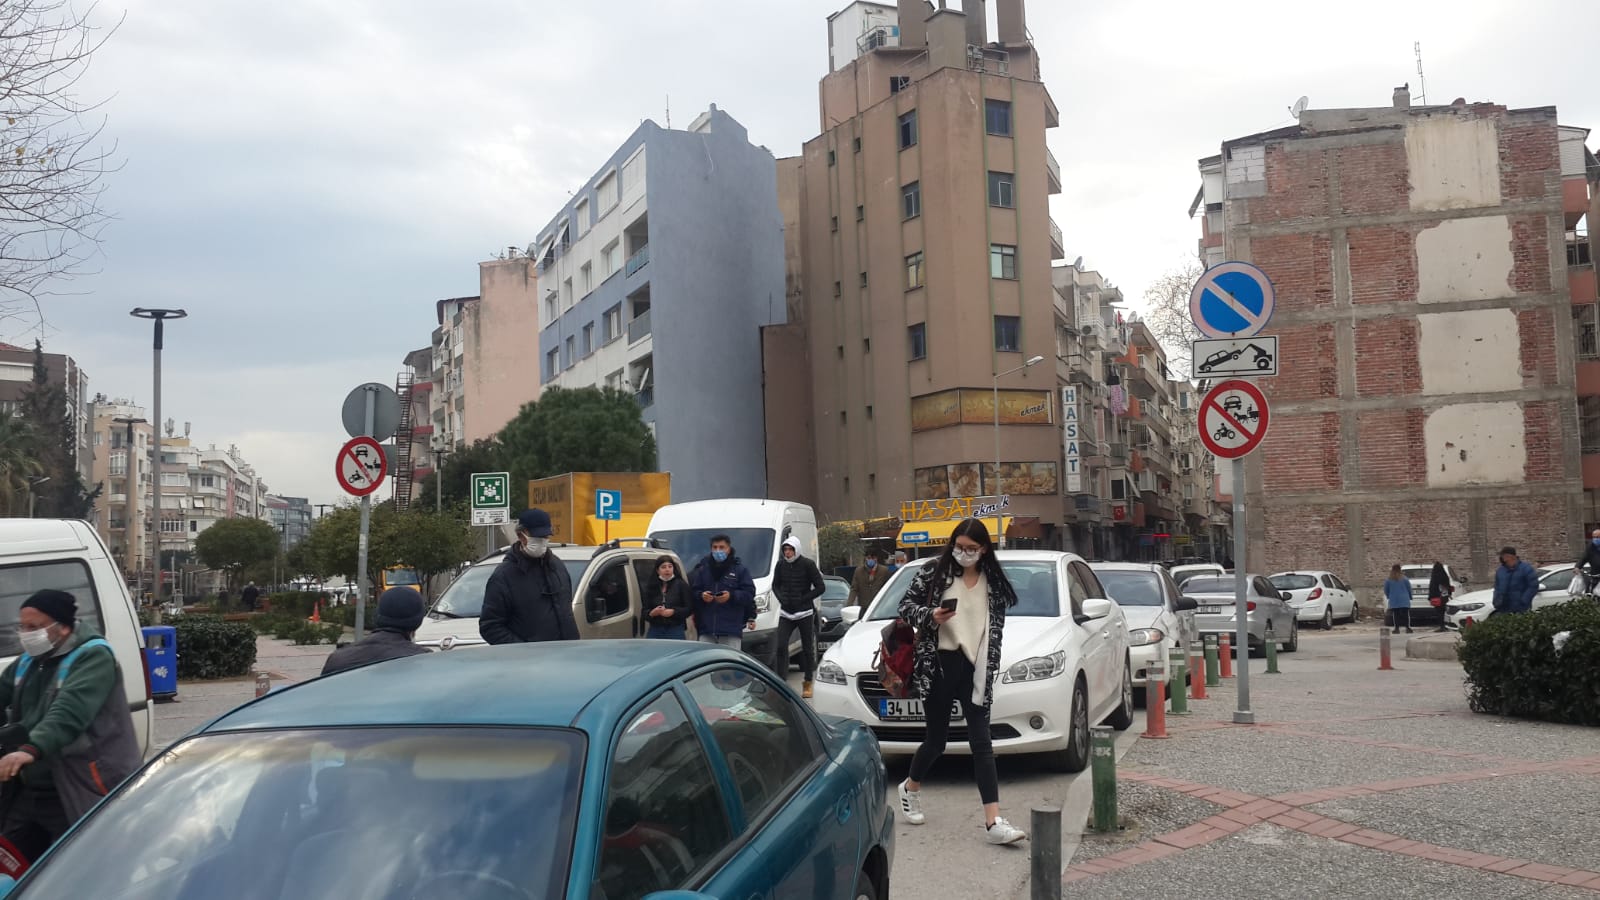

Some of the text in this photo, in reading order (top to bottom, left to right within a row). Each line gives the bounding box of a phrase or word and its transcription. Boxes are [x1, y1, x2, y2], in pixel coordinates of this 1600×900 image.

[1020, 400, 1046, 417] ekmek
[1064, 389, 1078, 472] HASAT
[599, 492, 614, 517] P
[901, 497, 974, 520] HASAT
[887, 701, 902, 715] 34
